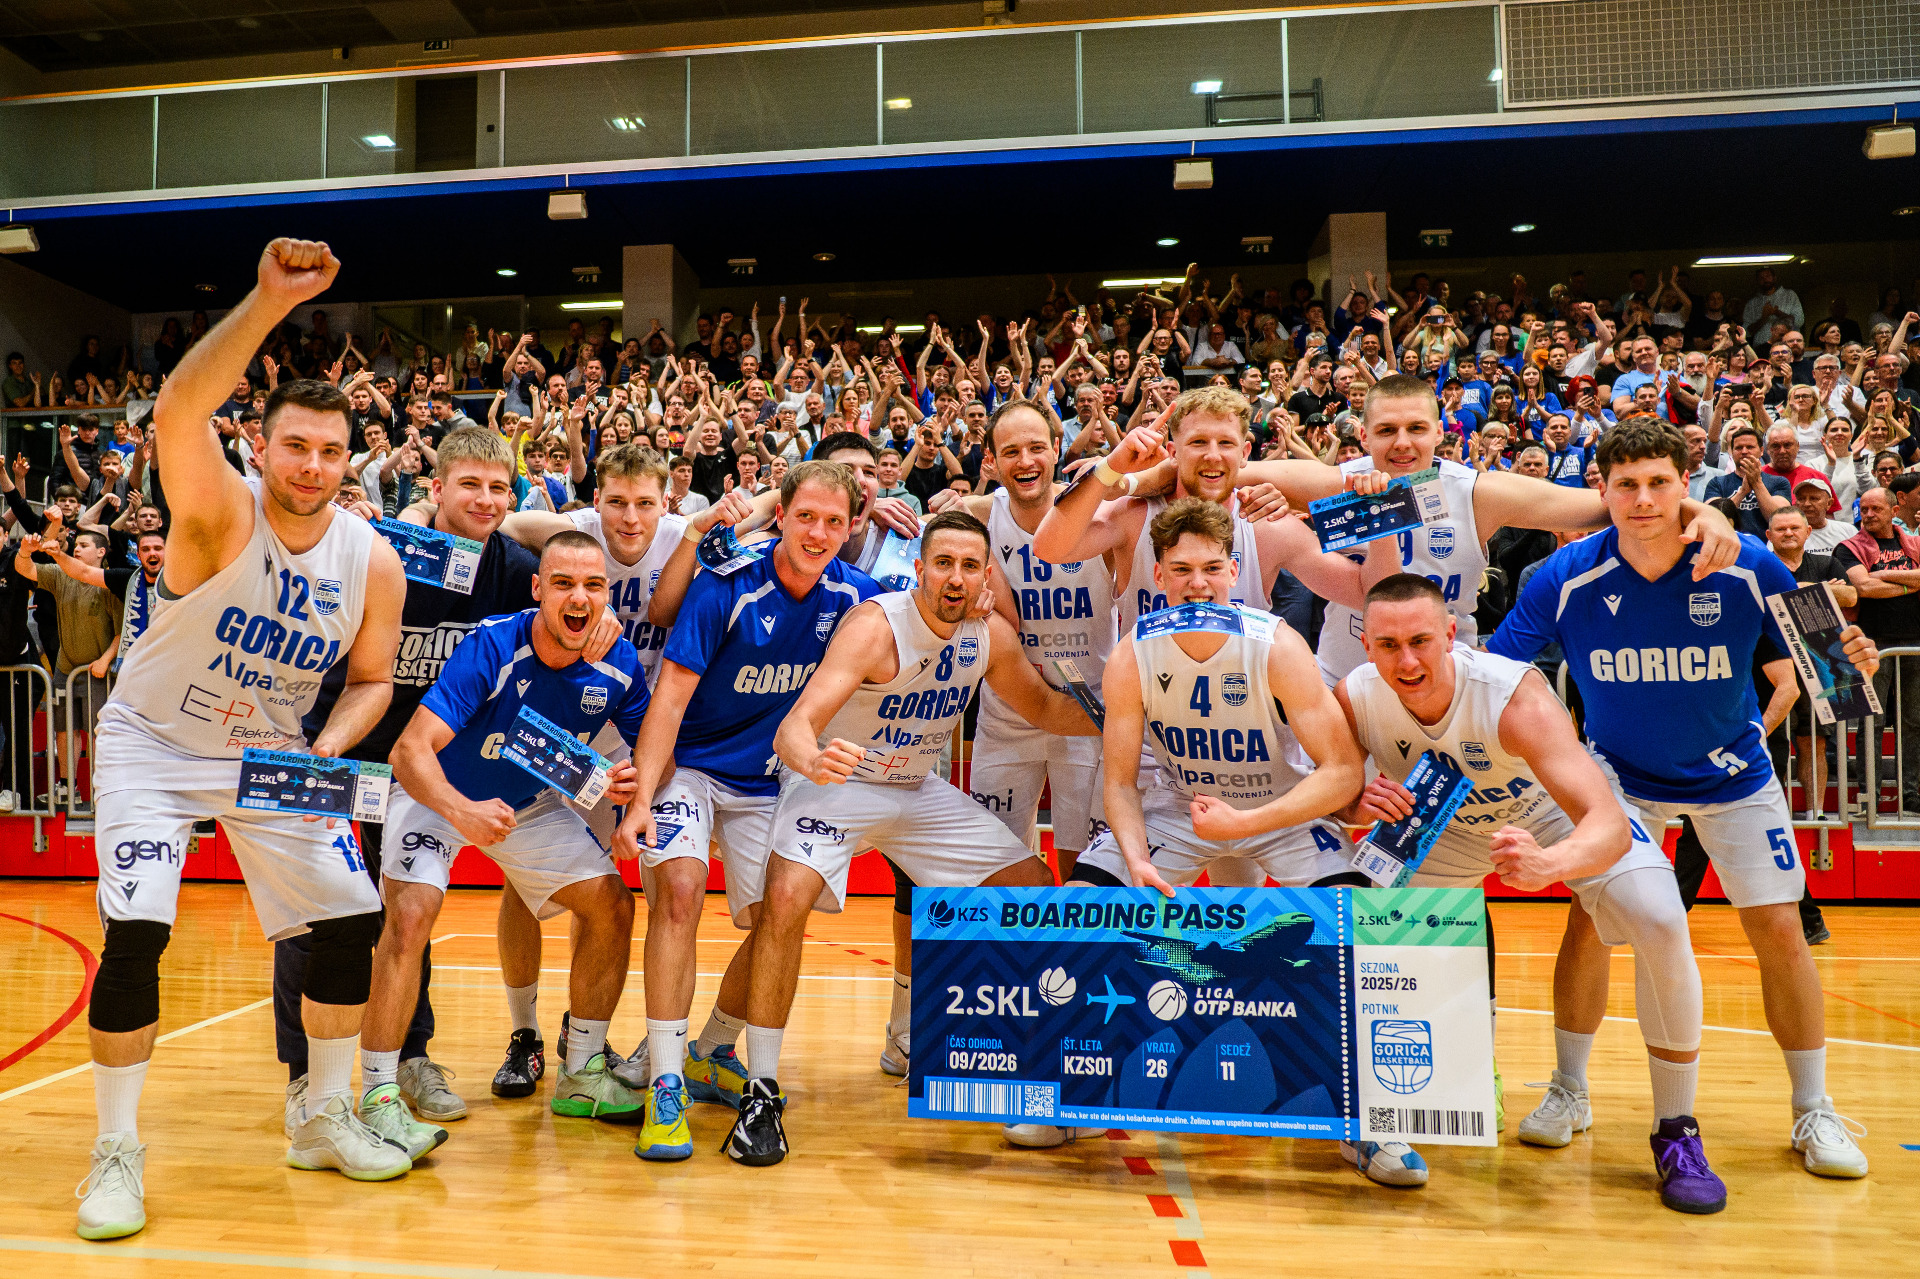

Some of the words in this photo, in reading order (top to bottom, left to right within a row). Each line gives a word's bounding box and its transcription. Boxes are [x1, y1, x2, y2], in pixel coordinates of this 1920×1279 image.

[375, 518, 414, 534] BOARDING
[413, 527, 434, 539] PASS
[1323, 516, 1348, 529] 2.SKL
[277, 568, 309, 622] 12
[609, 577, 641, 613] 14
[1011, 587, 1094, 621] RICA
[215, 606, 342, 673] GORICA
[619, 618, 668, 651] ICA
[1783, 623, 1798, 643] PASS
[395, 628, 465, 661] ORIC
[1044, 650, 1090, 658] SLOVENIJA
[935, 644, 955, 681] 8
[1589, 645, 1733, 683] GORICA
[1793, 643, 1814, 680] BOARDING
[207, 651, 320, 696] Alpacem
[877, 685, 972, 721] GORICA
[1189, 675, 1212, 718] 4
[517, 729, 538, 747] 2.SKL
[537, 718, 567, 744] BOARDING
[566, 736, 583, 752] PASS
[1149, 720, 1271, 763] GORICA
[268, 753, 312, 766] BOARDING
[312, 758, 335, 768] PASS
[1707, 746, 1749, 777] 5
[249, 773, 278, 785] 2.SKL
[1428, 774, 1449, 798] 2.SKL
[1221, 789, 1273, 799] SLOVENIJA
[1433, 797, 1459, 831] BOARDING
[1309, 825, 1342, 852] 4
[1421, 828, 1440, 850] PASS
[1766, 827, 1795, 871] 5
[115, 839, 180, 870] gen-i
[957, 907, 989, 922] KZS
[1000, 902, 1157, 930] BOARDING
[1162, 902, 1247, 931] PASS
[1358, 915, 1391, 926] 2.SKL
[1360, 962, 1400, 973] SEZONA
[1195, 987, 1235, 999] LIGA
[1361, 976, 1417, 991] 2025/26
[946, 985, 1039, 1017] 2.SKL
[1193, 999, 1231, 1016] OTP
[1232, 1001, 1298, 1018] BANKA
[1362, 1003, 1400, 1015] POTNIK
[949, 1035, 966, 1048] ČAS
[968, 1037, 1003, 1050] ODHODA
[1064, 1036, 1078, 1051] ŠT.
[1080, 1039, 1103, 1052] LETA
[1146, 1042, 1176, 1054] VRATA
[1220, 1043, 1252, 1057] SEDEŽ
[1374, 1044, 1430, 1057] GORICA
[949, 1051, 1018, 1072] 09/2026
[1064, 1055, 1113, 1076] KZS01
[1146, 1058, 1168, 1078] 26
[1220, 1061, 1236, 1081] 11
[1374, 1056, 1431, 1066] BASKETBALL
[1060, 1110, 1078, 1119] Hvala,
[1079, 1111, 1089, 1120] ker
[1090, 1112, 1099, 1120] ste
[1100, 1111, 1110, 1121] del
[1111, 1112, 1126, 1122] naše
[1126, 1113, 1164, 1124] košarkarske
[1164, 1115, 1190, 1125] družine.
[1190, 1115, 1211, 1126] Želimo
[1211, 1118, 1225, 1126] vam
[1226, 1119, 1253, 1128] uspešno
[1253, 1121, 1269, 1129] novo
[1270, 1120, 1307, 1130] tekmovalno
